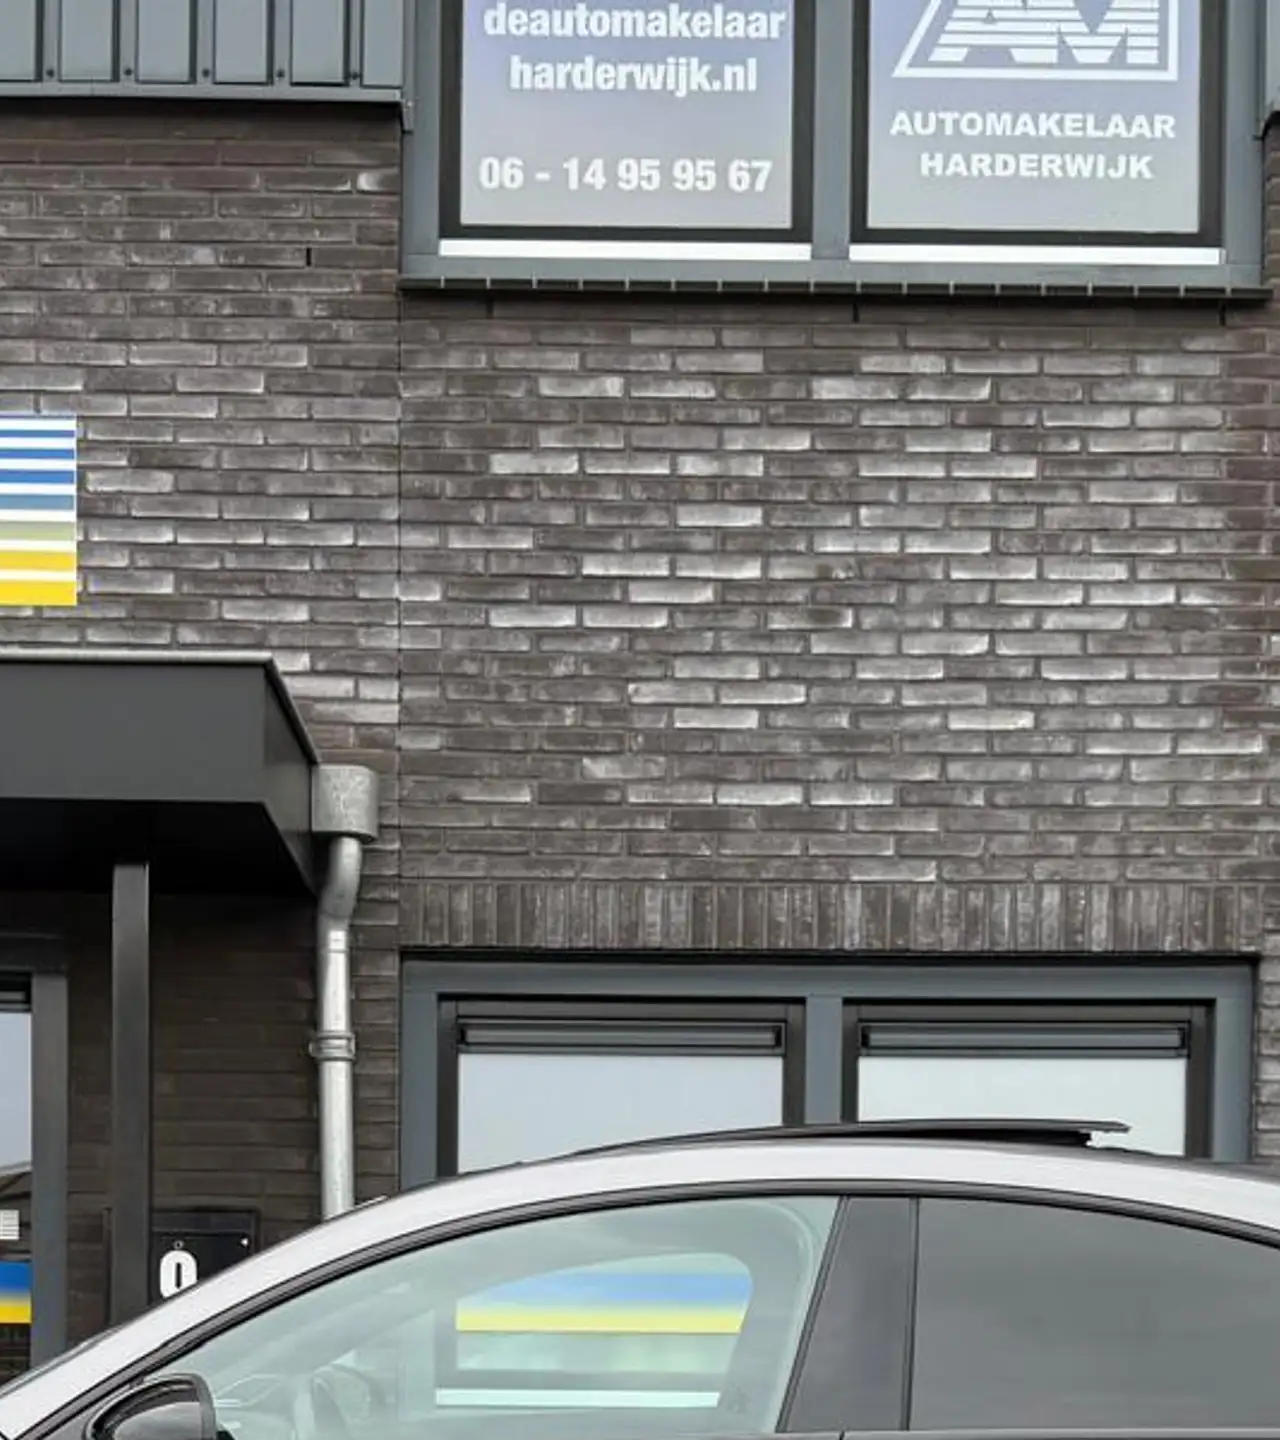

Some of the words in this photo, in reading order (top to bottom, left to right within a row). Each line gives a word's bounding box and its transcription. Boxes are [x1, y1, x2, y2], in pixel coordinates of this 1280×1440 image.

[483, 1, 787, 39] deautomakelaar
[509, 54, 758, 98] harderwijk.nl
[889, 110, 1177, 140] AUTOMAKELAAR
[478, 156, 525, 190] 06
[563, 157, 606, 191] 14
[617, 158, 661, 191] 95
[672, 158, 717, 192] 95
[727, 159, 774, 193] 67
[919, 152, 1156, 180] HARDERWIJK
